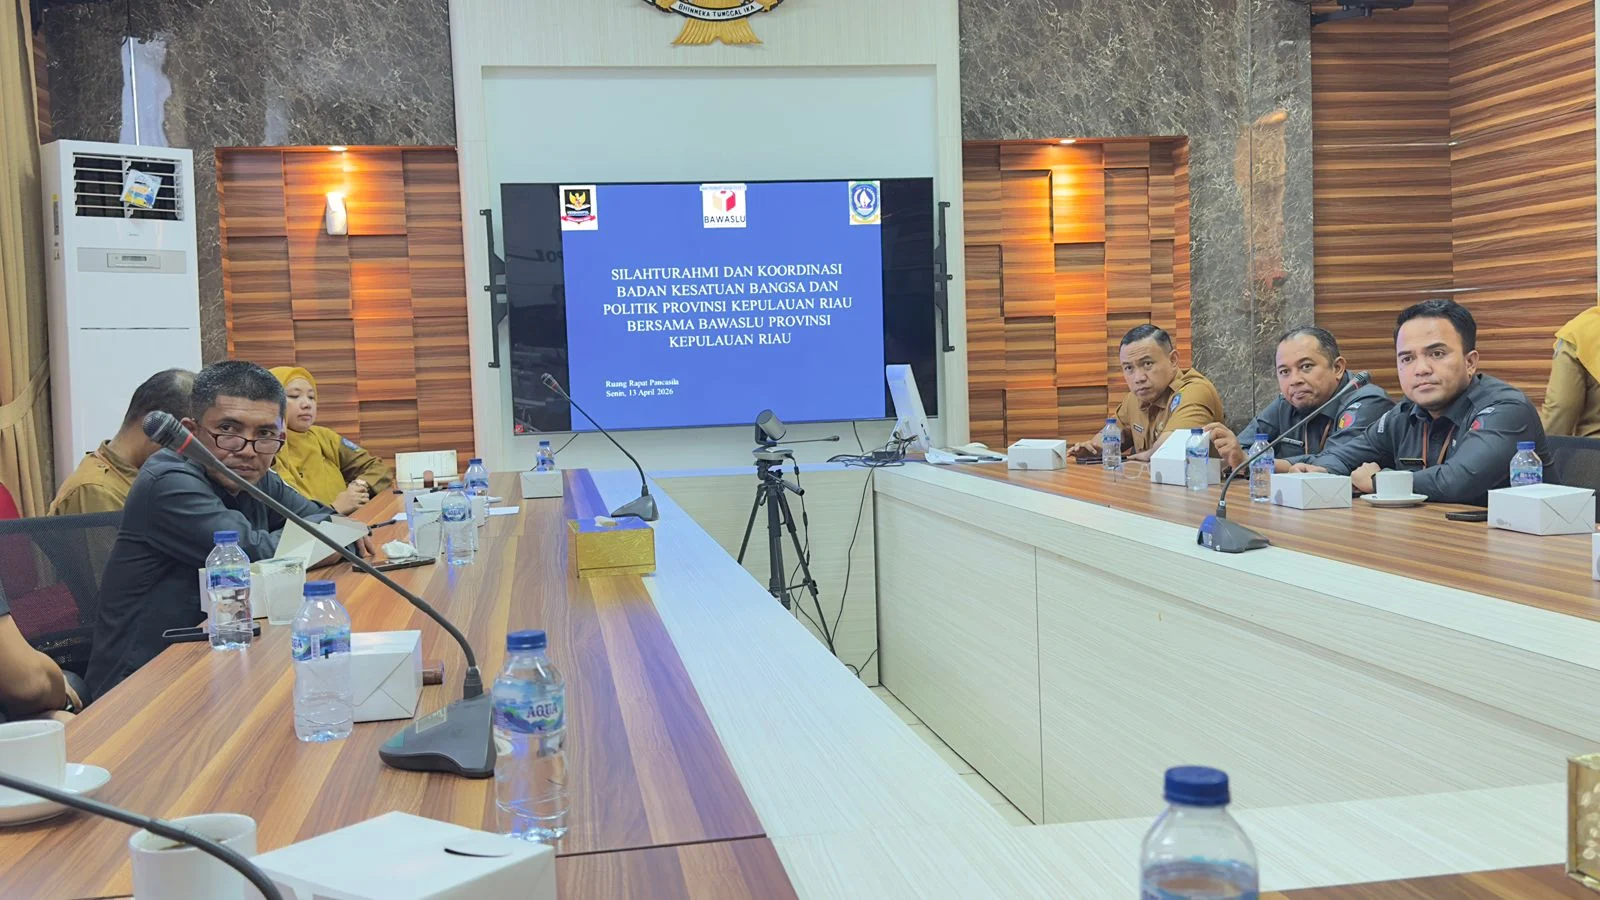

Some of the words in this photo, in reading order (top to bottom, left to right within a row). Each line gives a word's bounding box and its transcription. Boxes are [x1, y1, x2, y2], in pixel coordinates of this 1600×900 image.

[678, 3, 710, 17] BHINNEKA
[711, 9, 742, 17] TUNGGAL
[743, 4, 755, 13] IKA
[704, 215, 746, 224] BAWASLU
[611, 266, 719, 280] SILAHTURAHMI
[723, 265, 753, 278] DAN
[757, 263, 843, 277] KOORDINASI
[617, 285, 667, 298] BADAN
[671, 283, 744, 296] KESATUAN
[749, 281, 806, 294] BANGSA
[809, 280, 839, 293] DAN
[603, 302, 659, 316] POLITIK
[662, 300, 727, 314] PROVINSI
[731, 298, 815, 312] KEPULAUAN
[820, 296, 853, 309] RIAU
[627, 319, 695, 332] BERSAMA
[698, 316, 764, 330] BAWASLU
[768, 314, 831, 328] PROVINSI
[669, 334, 754, 348] KEPULAUAN
[758, 332, 792, 345] RIAU
[605, 380, 627, 389] Ruang
[629, 379, 648, 388] Rapat
[649, 378, 680, 386] Pancasila
[638, 388, 655, 397] April
[527, 702, 558, 718] AQUA
